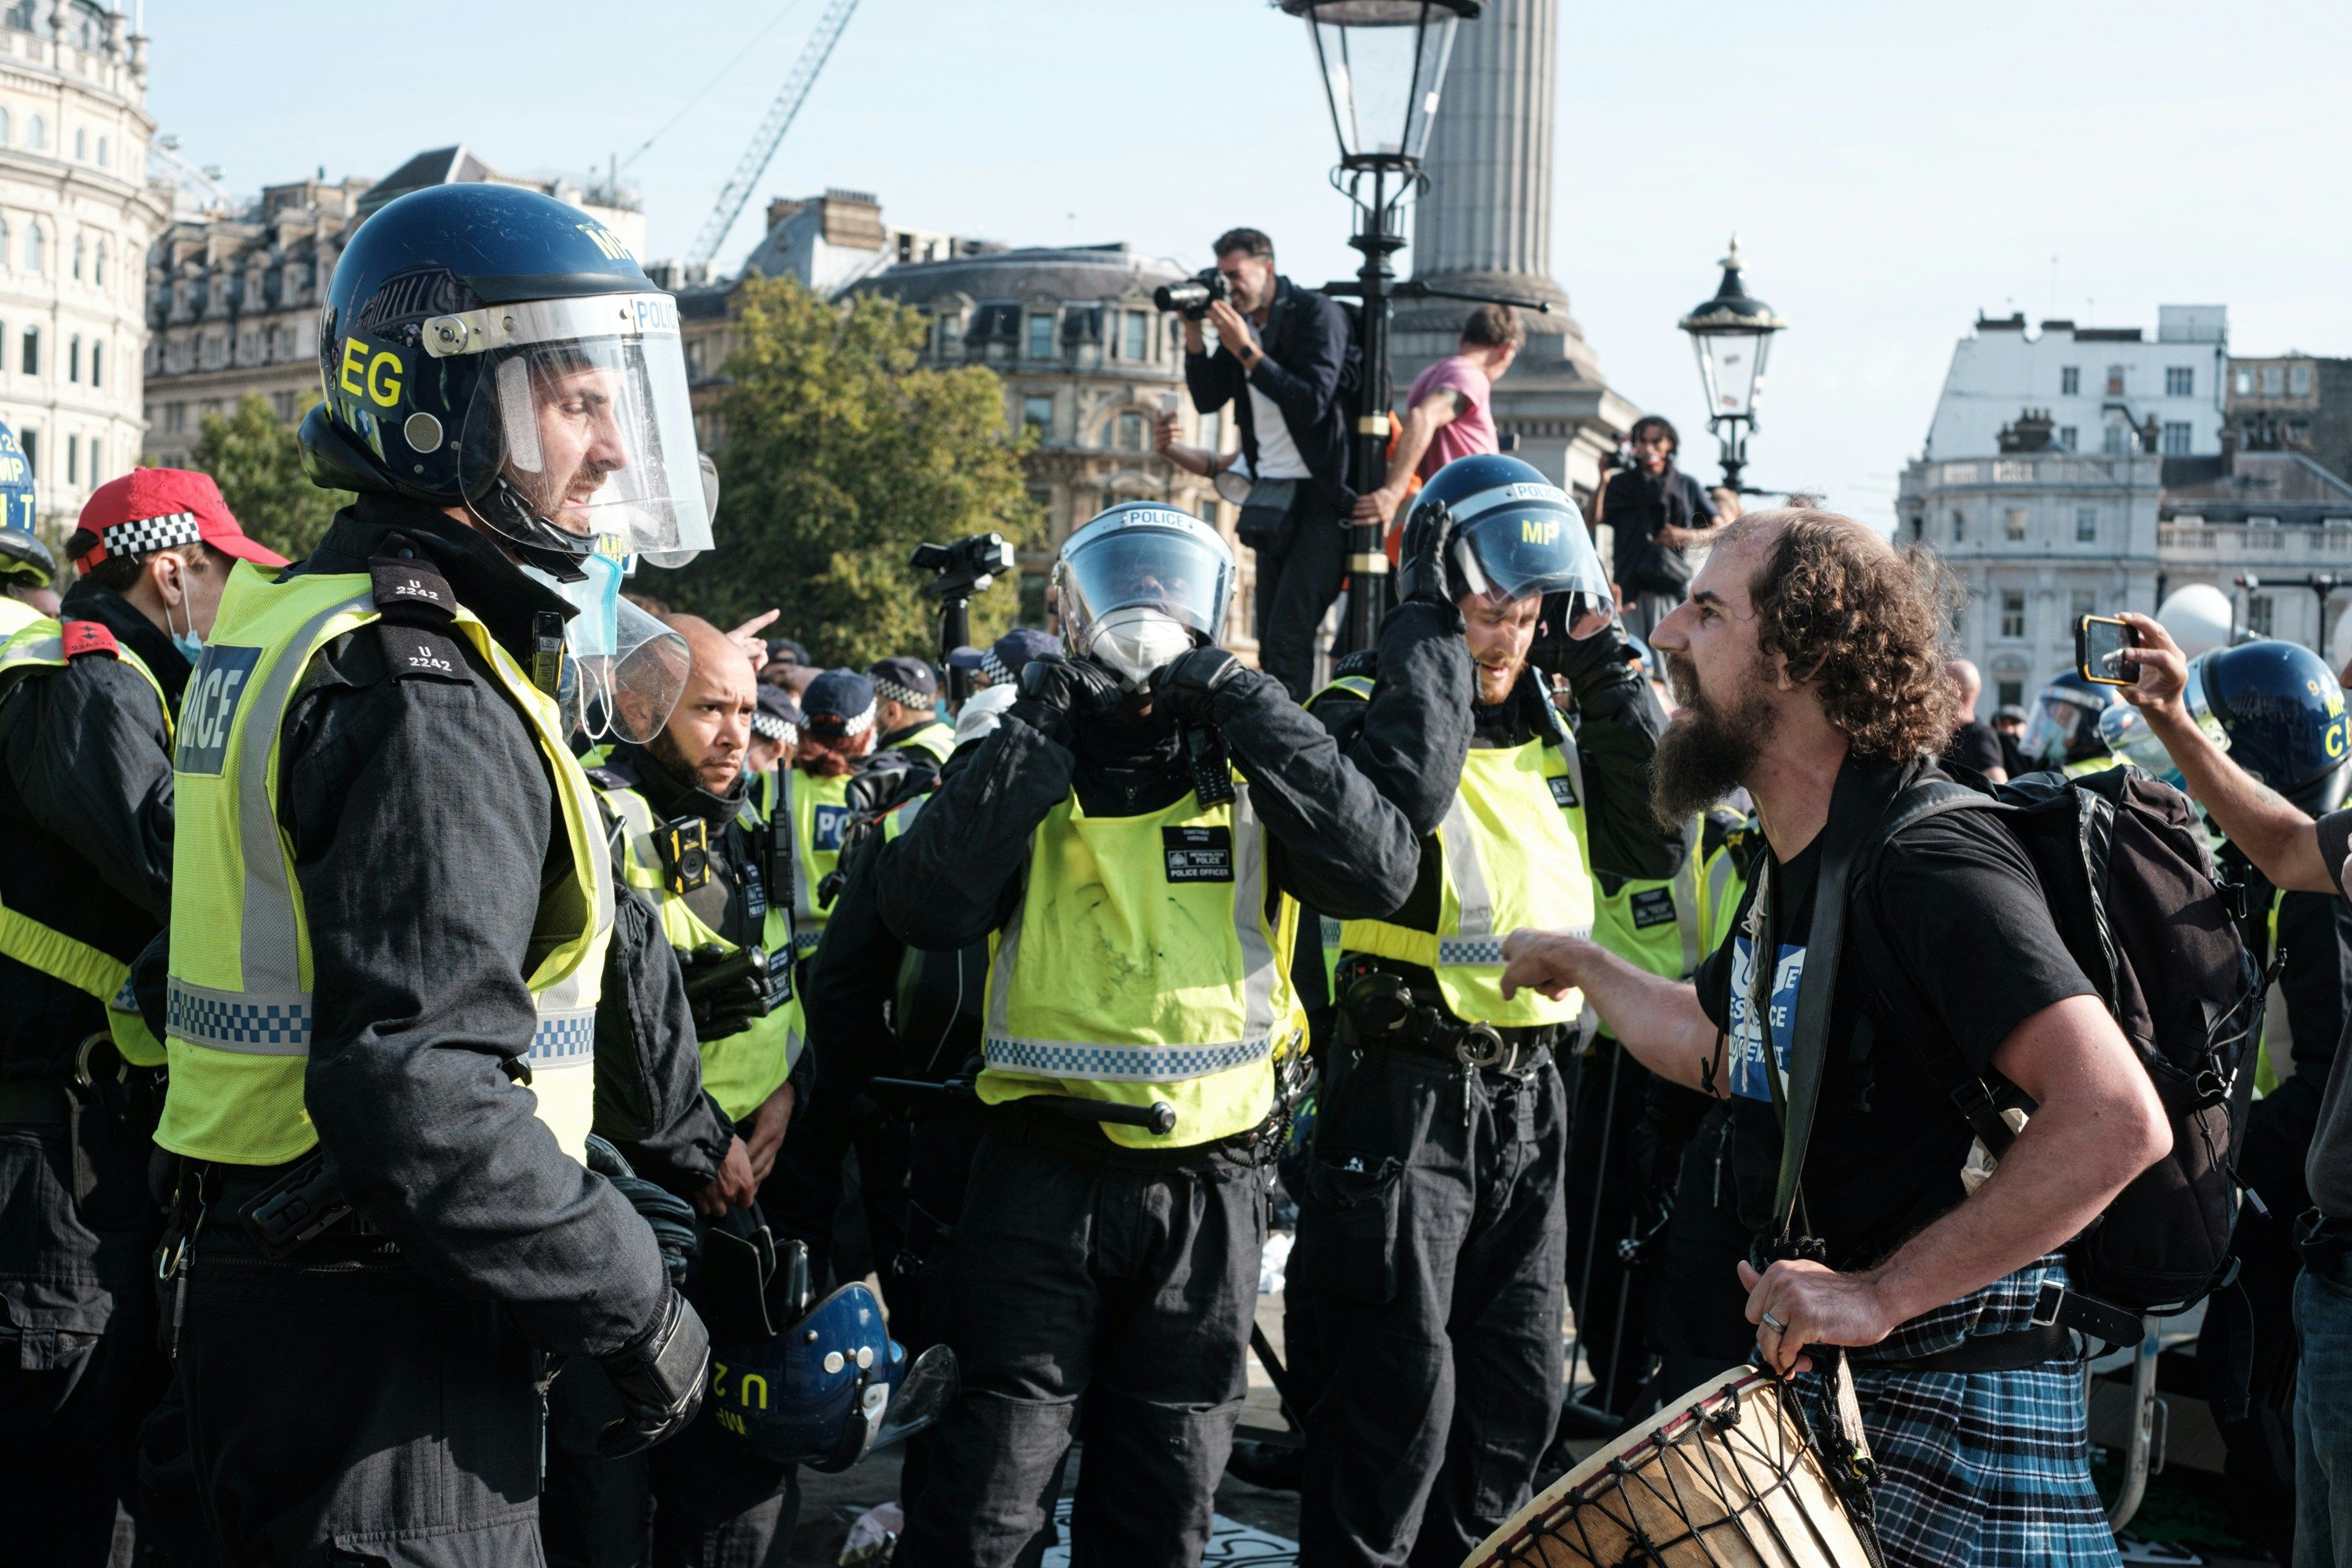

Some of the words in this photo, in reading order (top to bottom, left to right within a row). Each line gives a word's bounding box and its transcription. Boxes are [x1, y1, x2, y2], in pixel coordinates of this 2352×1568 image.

[340, 336, 403, 407] EG
[1131, 511, 1184, 527] POLICE
[1522, 519, 1559, 546] MP
[409, 579, 421, 588] U
[396, 586, 439, 601] 2242
[418, 646, 431, 657] U
[408, 657, 452, 672] 2242
